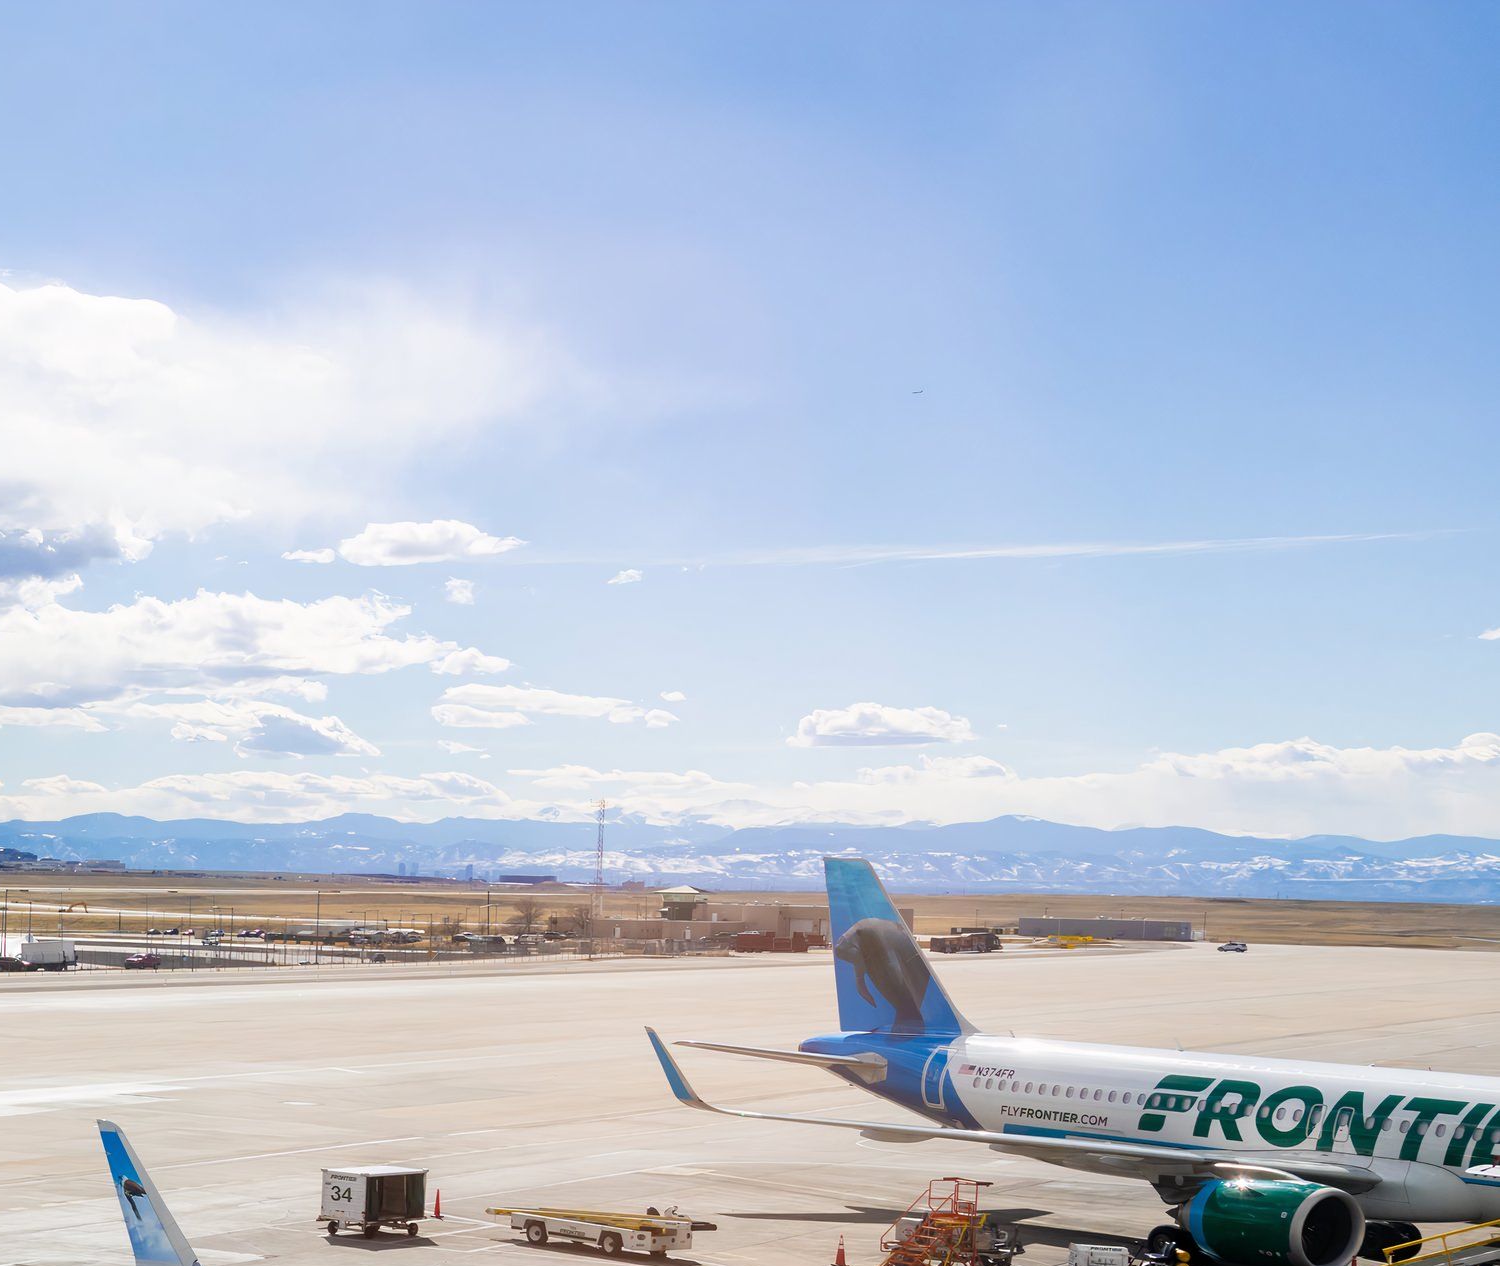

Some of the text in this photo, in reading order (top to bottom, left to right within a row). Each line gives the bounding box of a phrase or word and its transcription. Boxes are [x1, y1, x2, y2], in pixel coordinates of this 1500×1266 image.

[975, 1066, 1015, 1079] N374FR
[1000, 1105, 1108, 1127] FLYFRONTIER.COM
[330, 1185, 353, 1203] 34
